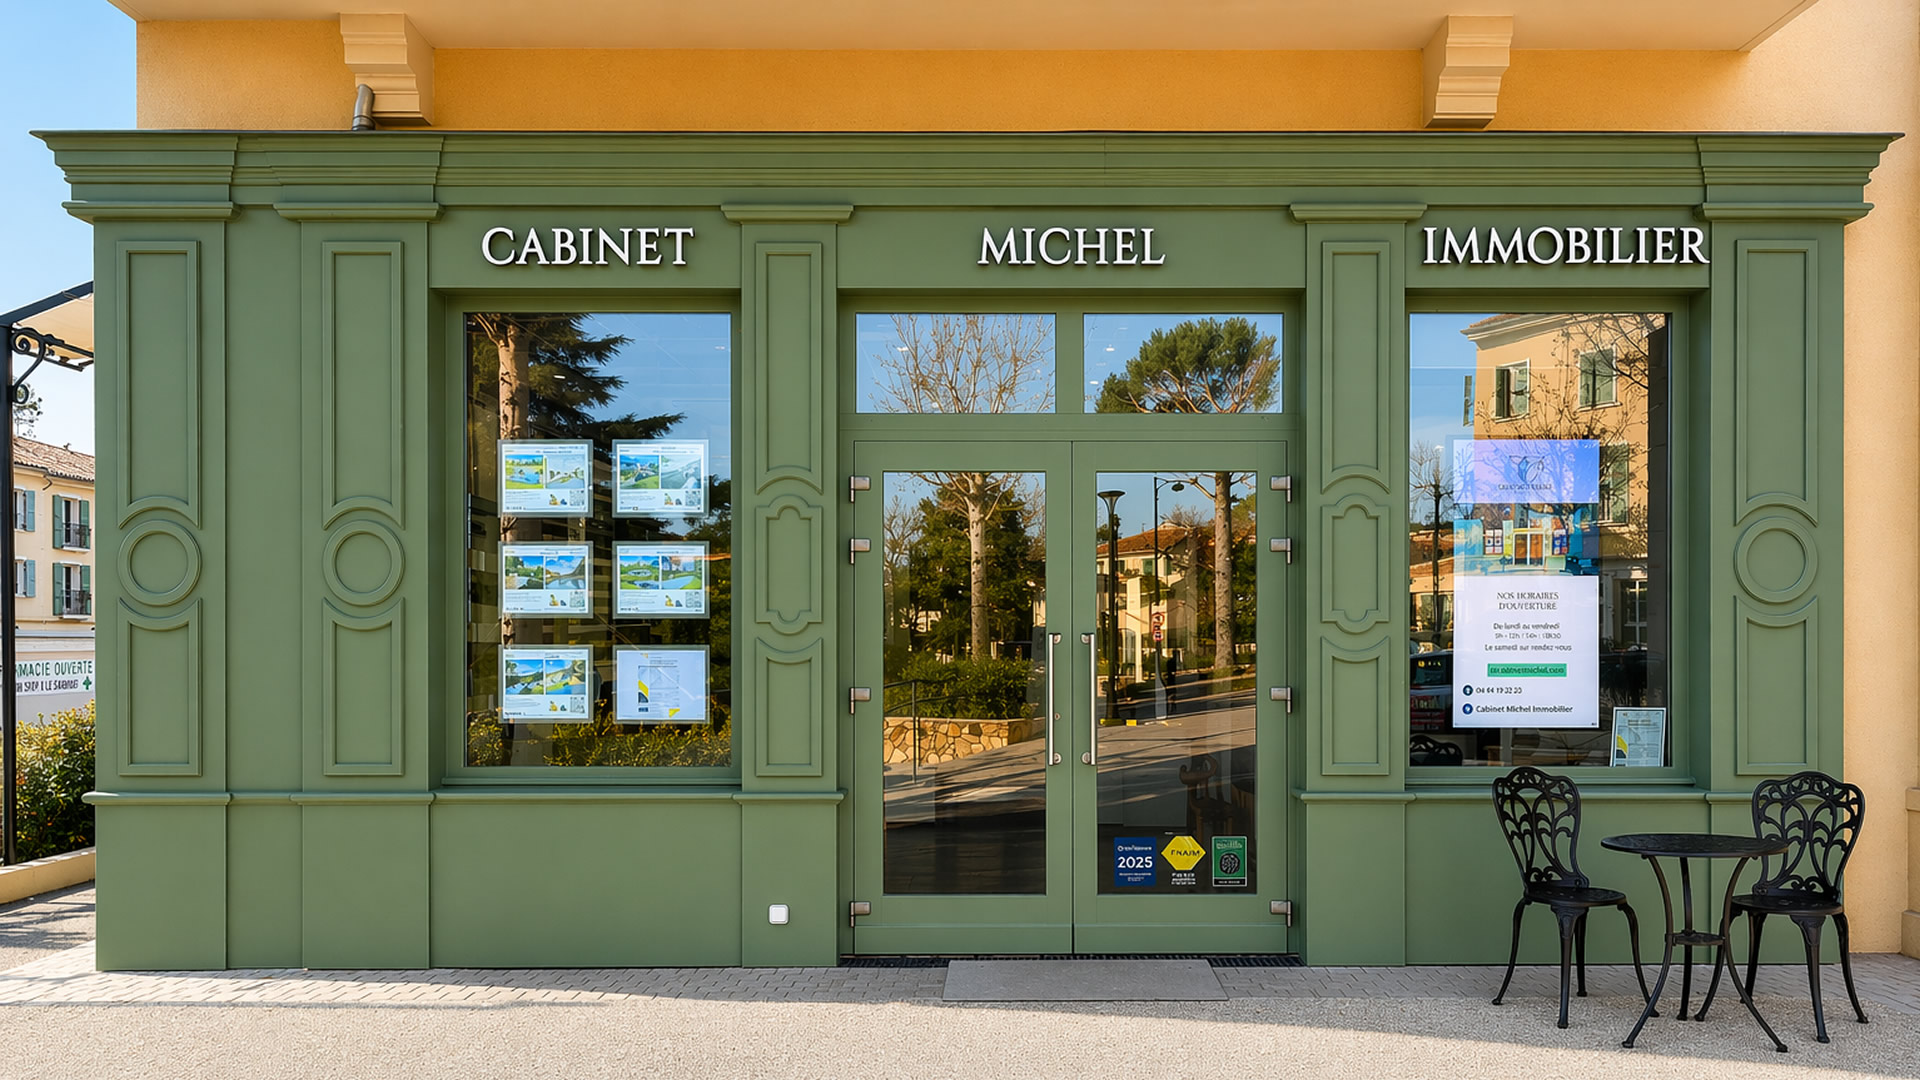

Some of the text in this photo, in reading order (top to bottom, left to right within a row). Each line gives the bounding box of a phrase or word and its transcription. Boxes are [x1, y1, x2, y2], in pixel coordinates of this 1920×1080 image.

[481, 226, 695, 266] CABINET
[977, 226, 1166, 265] MICHEL
[1422, 225, 1711, 265] IMMOBILIER
[1497, 592, 1514, 600] NOS
[54, 660, 93, 676] OUVERTE
[1476, 705, 1573, 713] Cabinet Michel Immobilier
[1117, 856, 1153, 869] 2025
